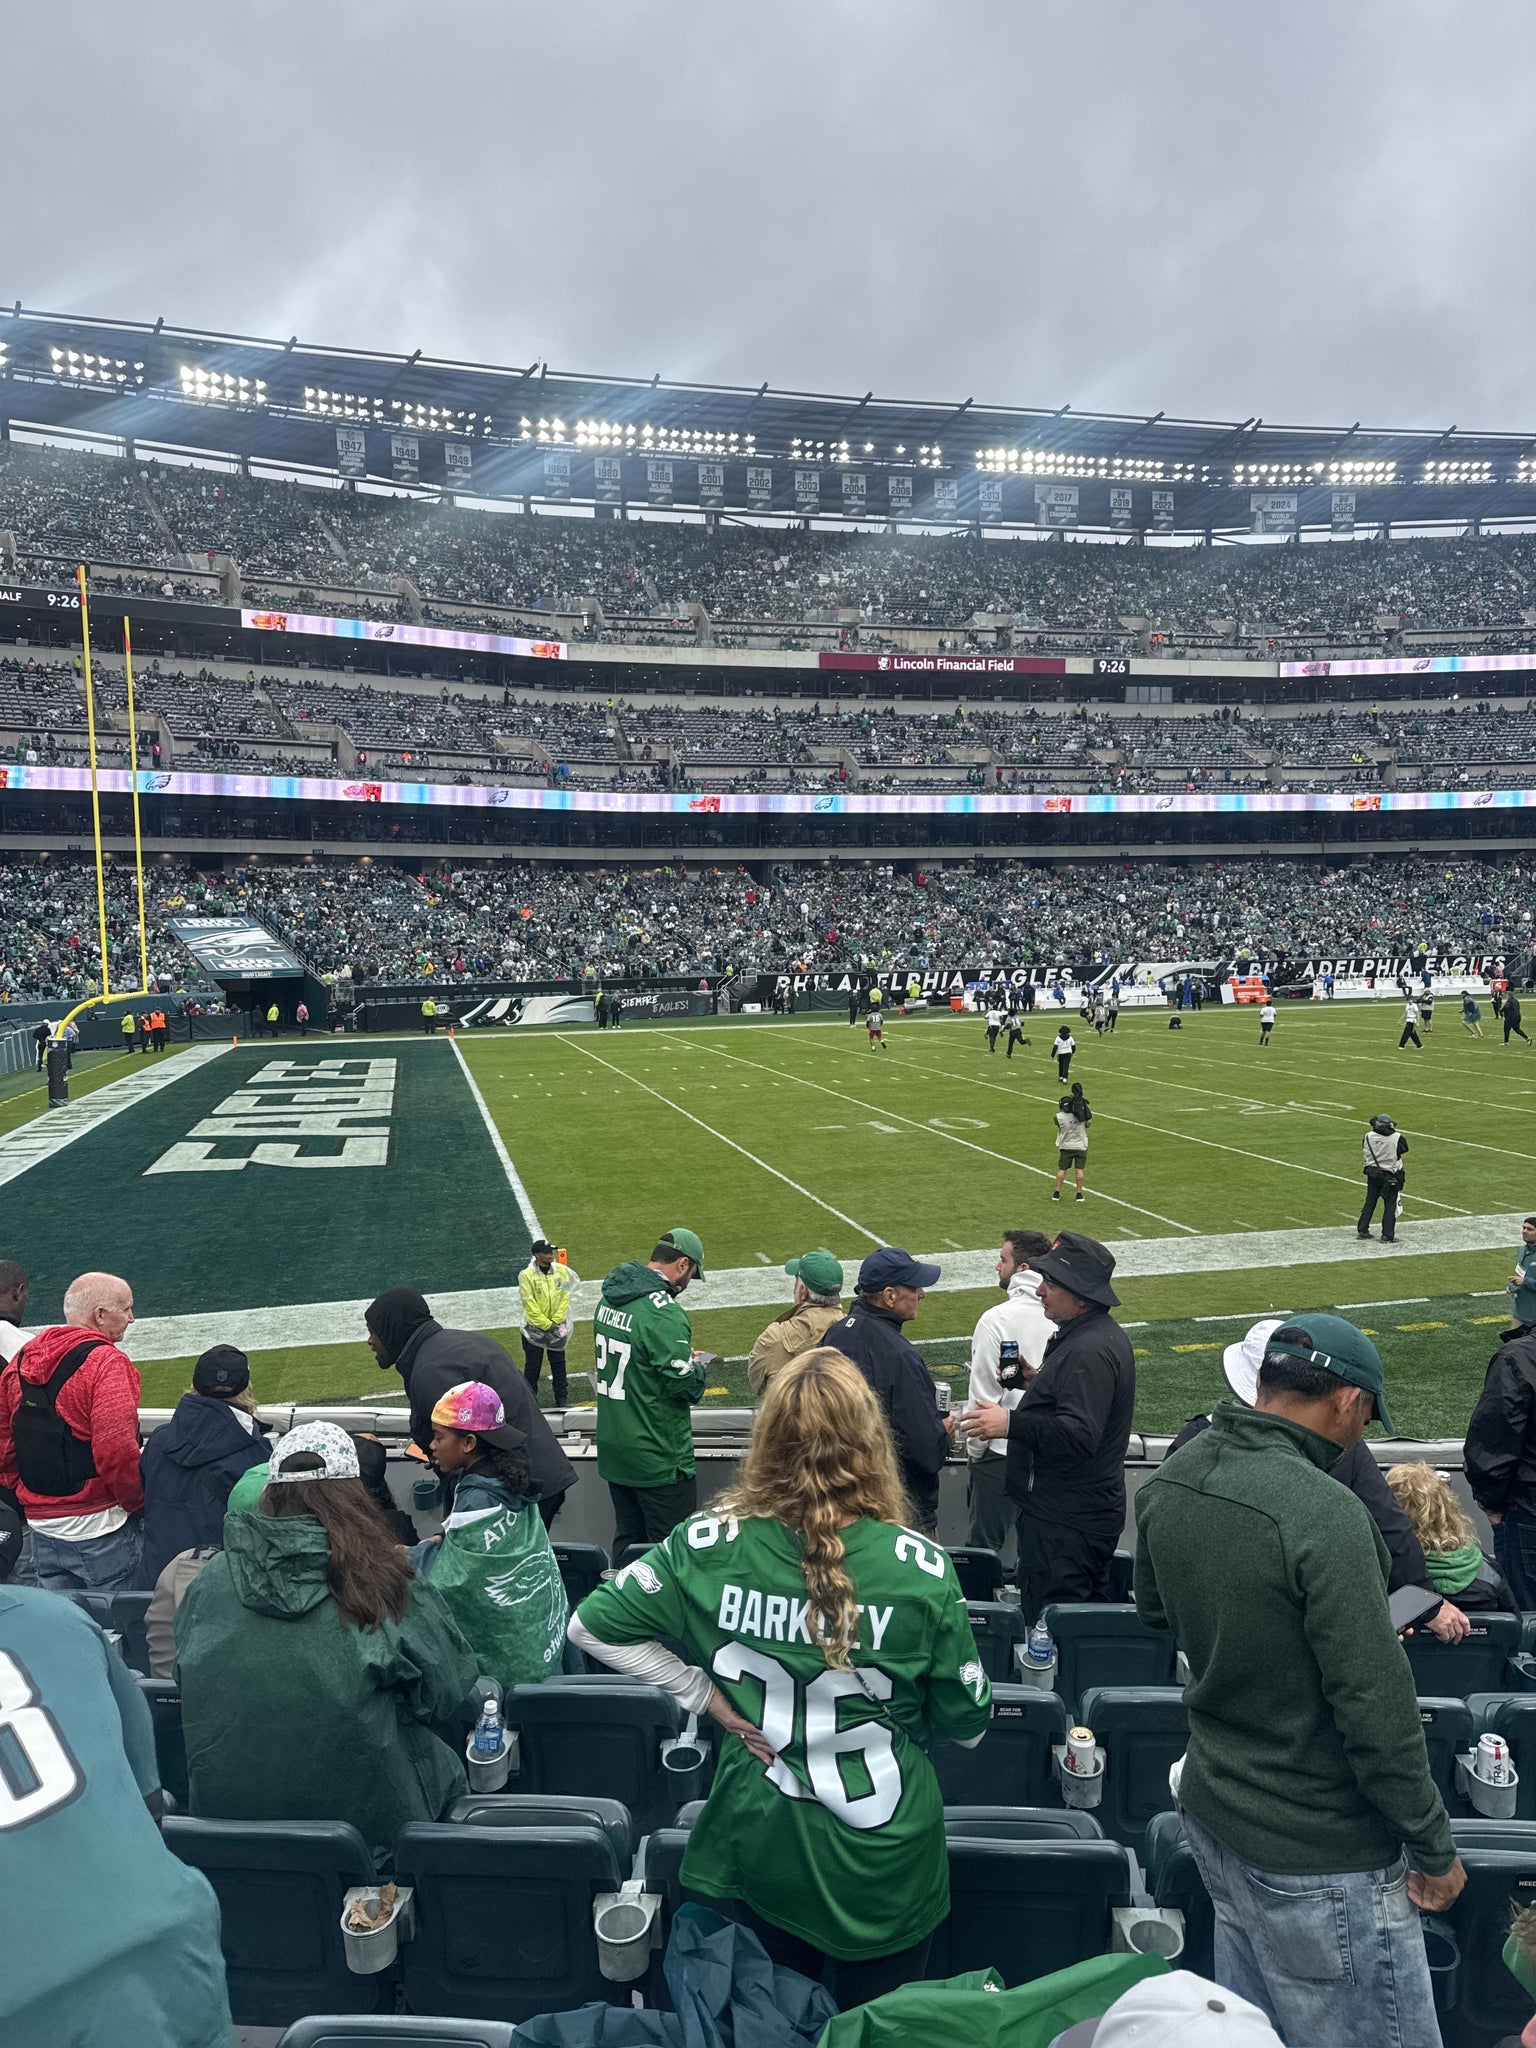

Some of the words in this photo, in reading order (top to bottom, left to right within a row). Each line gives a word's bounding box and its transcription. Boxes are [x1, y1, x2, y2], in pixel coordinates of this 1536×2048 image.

[340, 440, 362, 451] 1947
[395, 446, 415, 458] 1948
[449, 454, 468, 465] 1949
[548, 464, 567, 474] 1960
[598, 468, 618, 478] 1980
[651, 471, 670, 481] 1988
[702, 475, 720, 484] 2001
[749, 478, 769, 487] 2002
[797, 481, 818, 490] 2003
[844, 484, 864, 493] 2004
[891, 487, 910, 495] 2006
[982, 491, 999, 500] 2013
[1055, 493, 1072, 502] 2017
[1113, 499, 1130, 507] 2019
[1154, 501, 1172, 509] 2022
[1334, 503, 1354, 511] 2025
[47, 594, 79, 608] 9:26
[894, 658, 934, 670] Lincoln
[937, 658, 987, 671] Financial
[988, 659, 1014, 671] Field
[1100, 660, 1125, 673] 9:26
[979, 968, 1073, 987] EAGLES
[621, 995, 660, 1008] SIEMPRE
[652, 1000, 689, 1012] EAGLES!
[142, 1058, 397, 1175] EAGLES
[597, 1305, 632, 1332] MITCHELL
[596, 1333, 631, 1400] 27
[713, 1640, 902, 1829] 26
